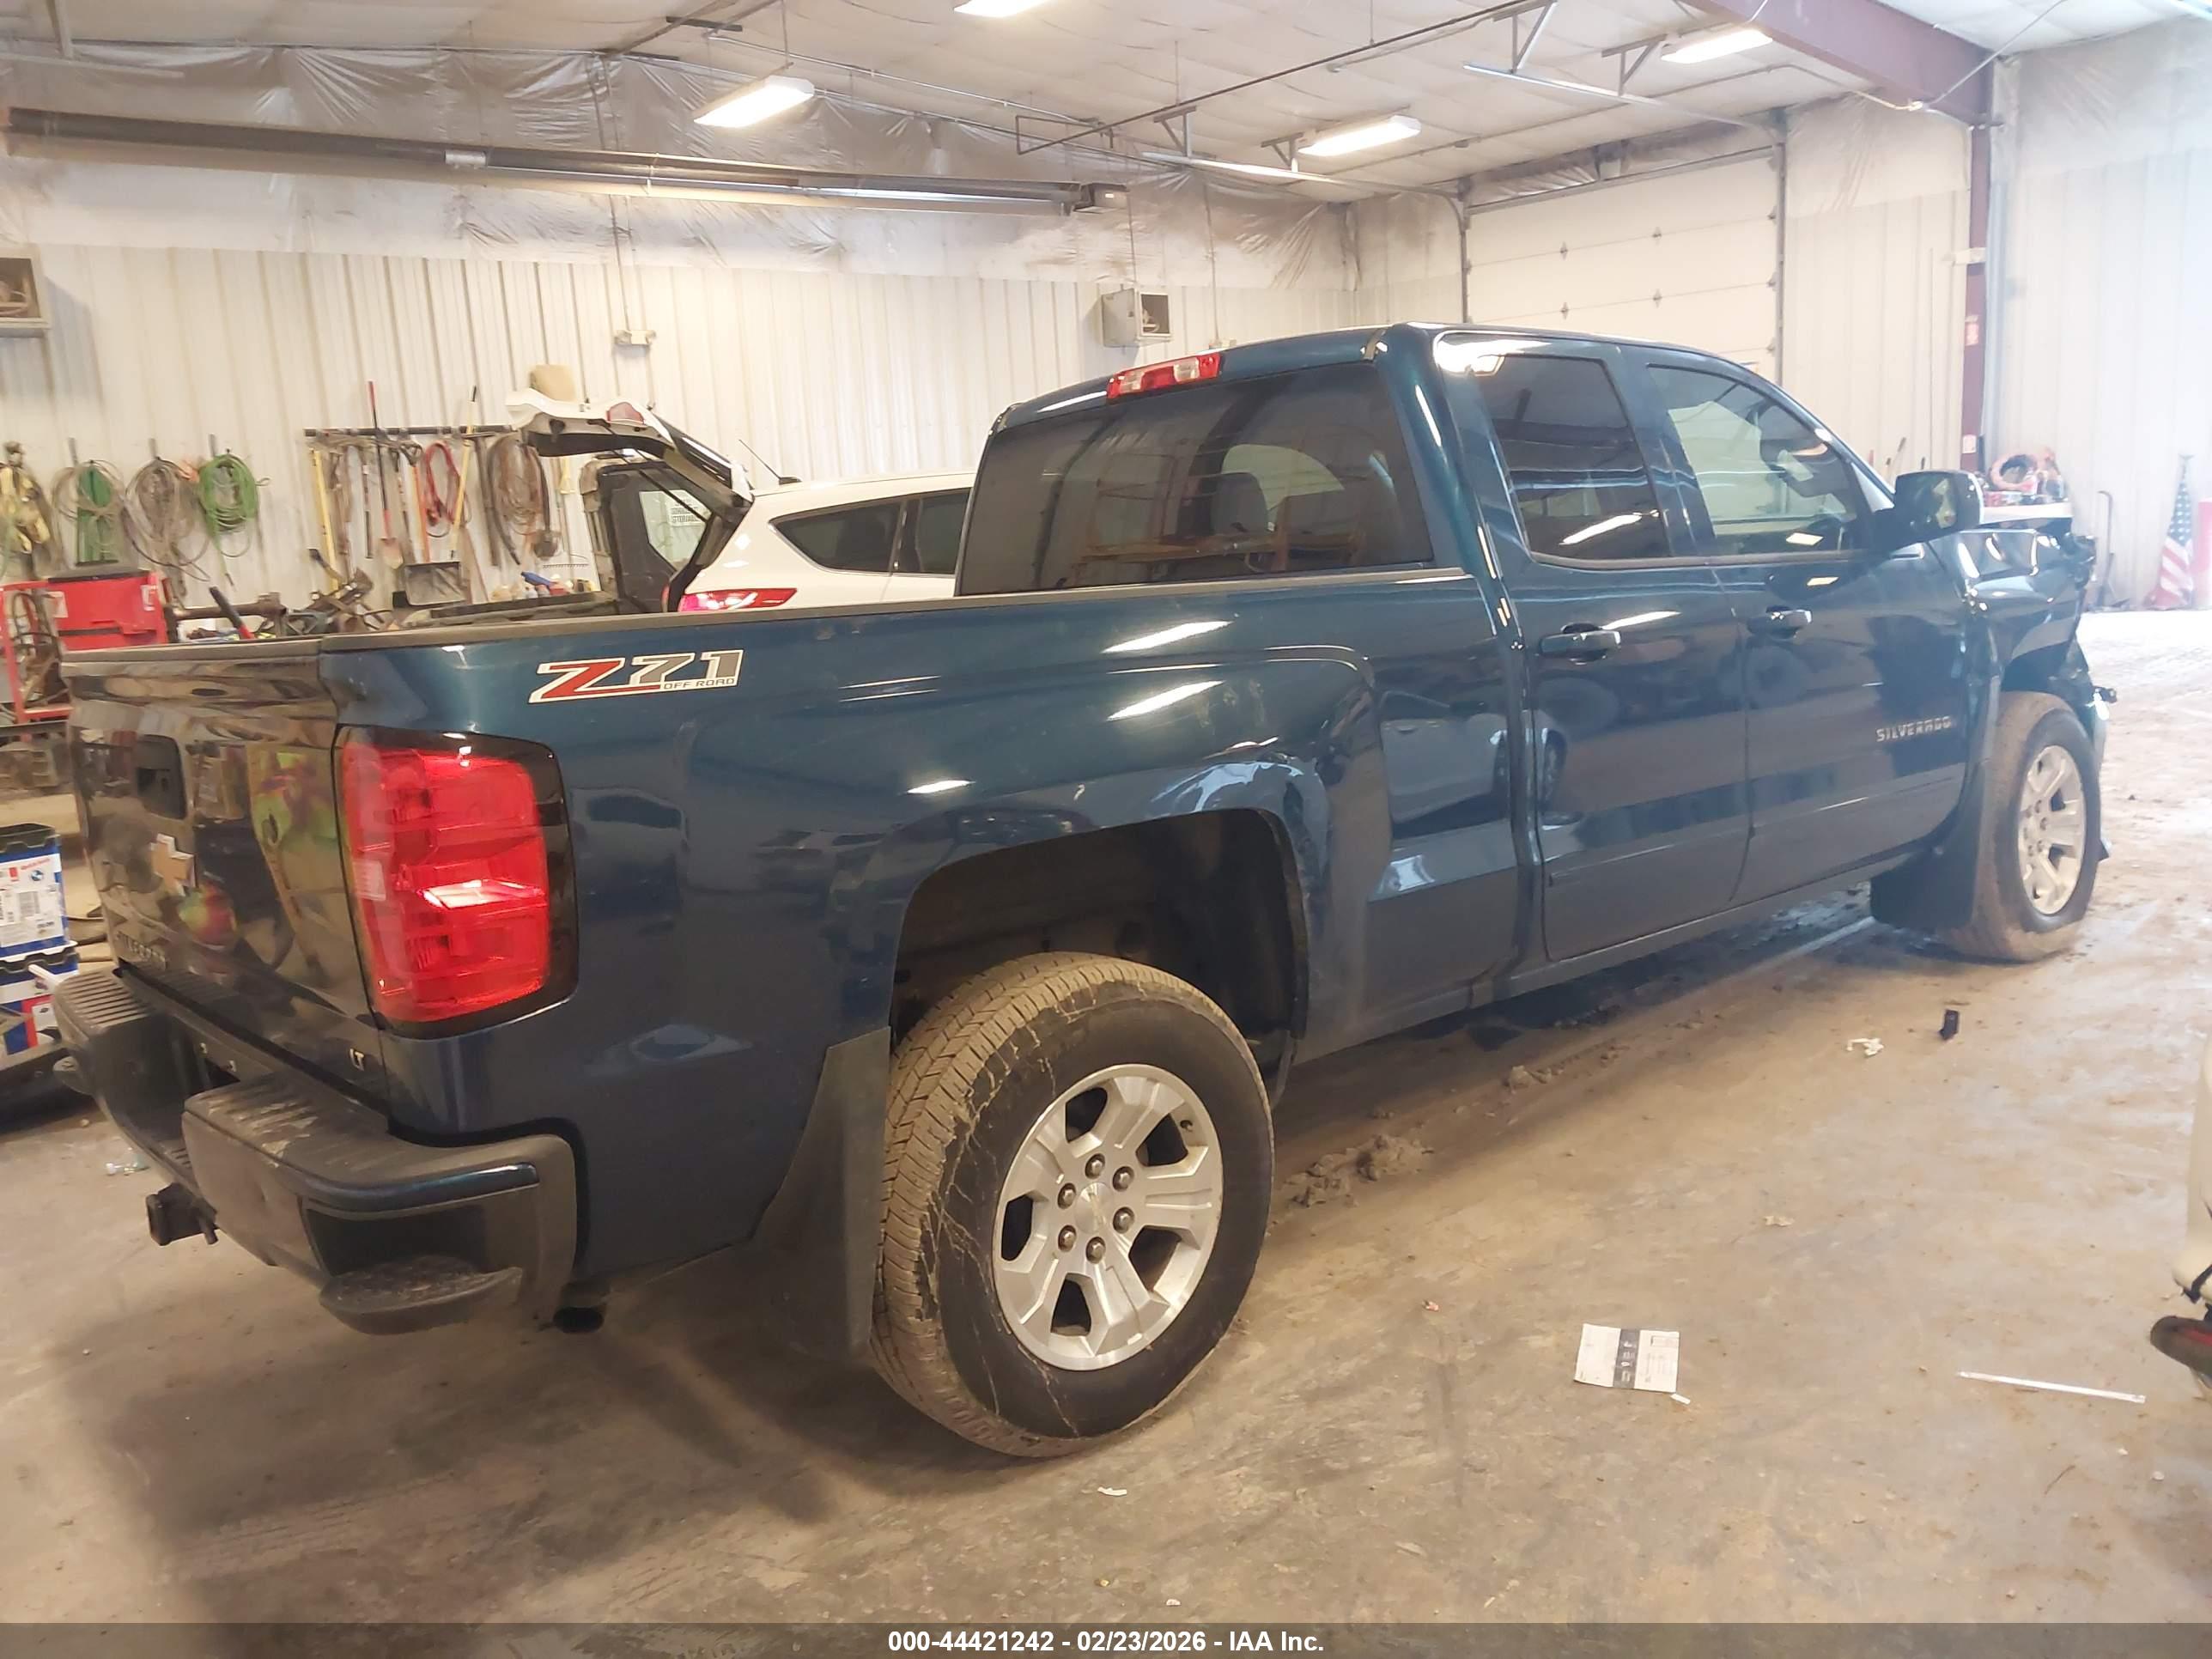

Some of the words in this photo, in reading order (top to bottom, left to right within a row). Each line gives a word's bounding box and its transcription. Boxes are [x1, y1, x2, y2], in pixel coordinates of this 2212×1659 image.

[527, 649, 744, 704] Z71
[664, 681, 691, 690] OFF
[696, 678, 735, 688] ROAD
[1875, 715, 1952, 742] SILVERADO
